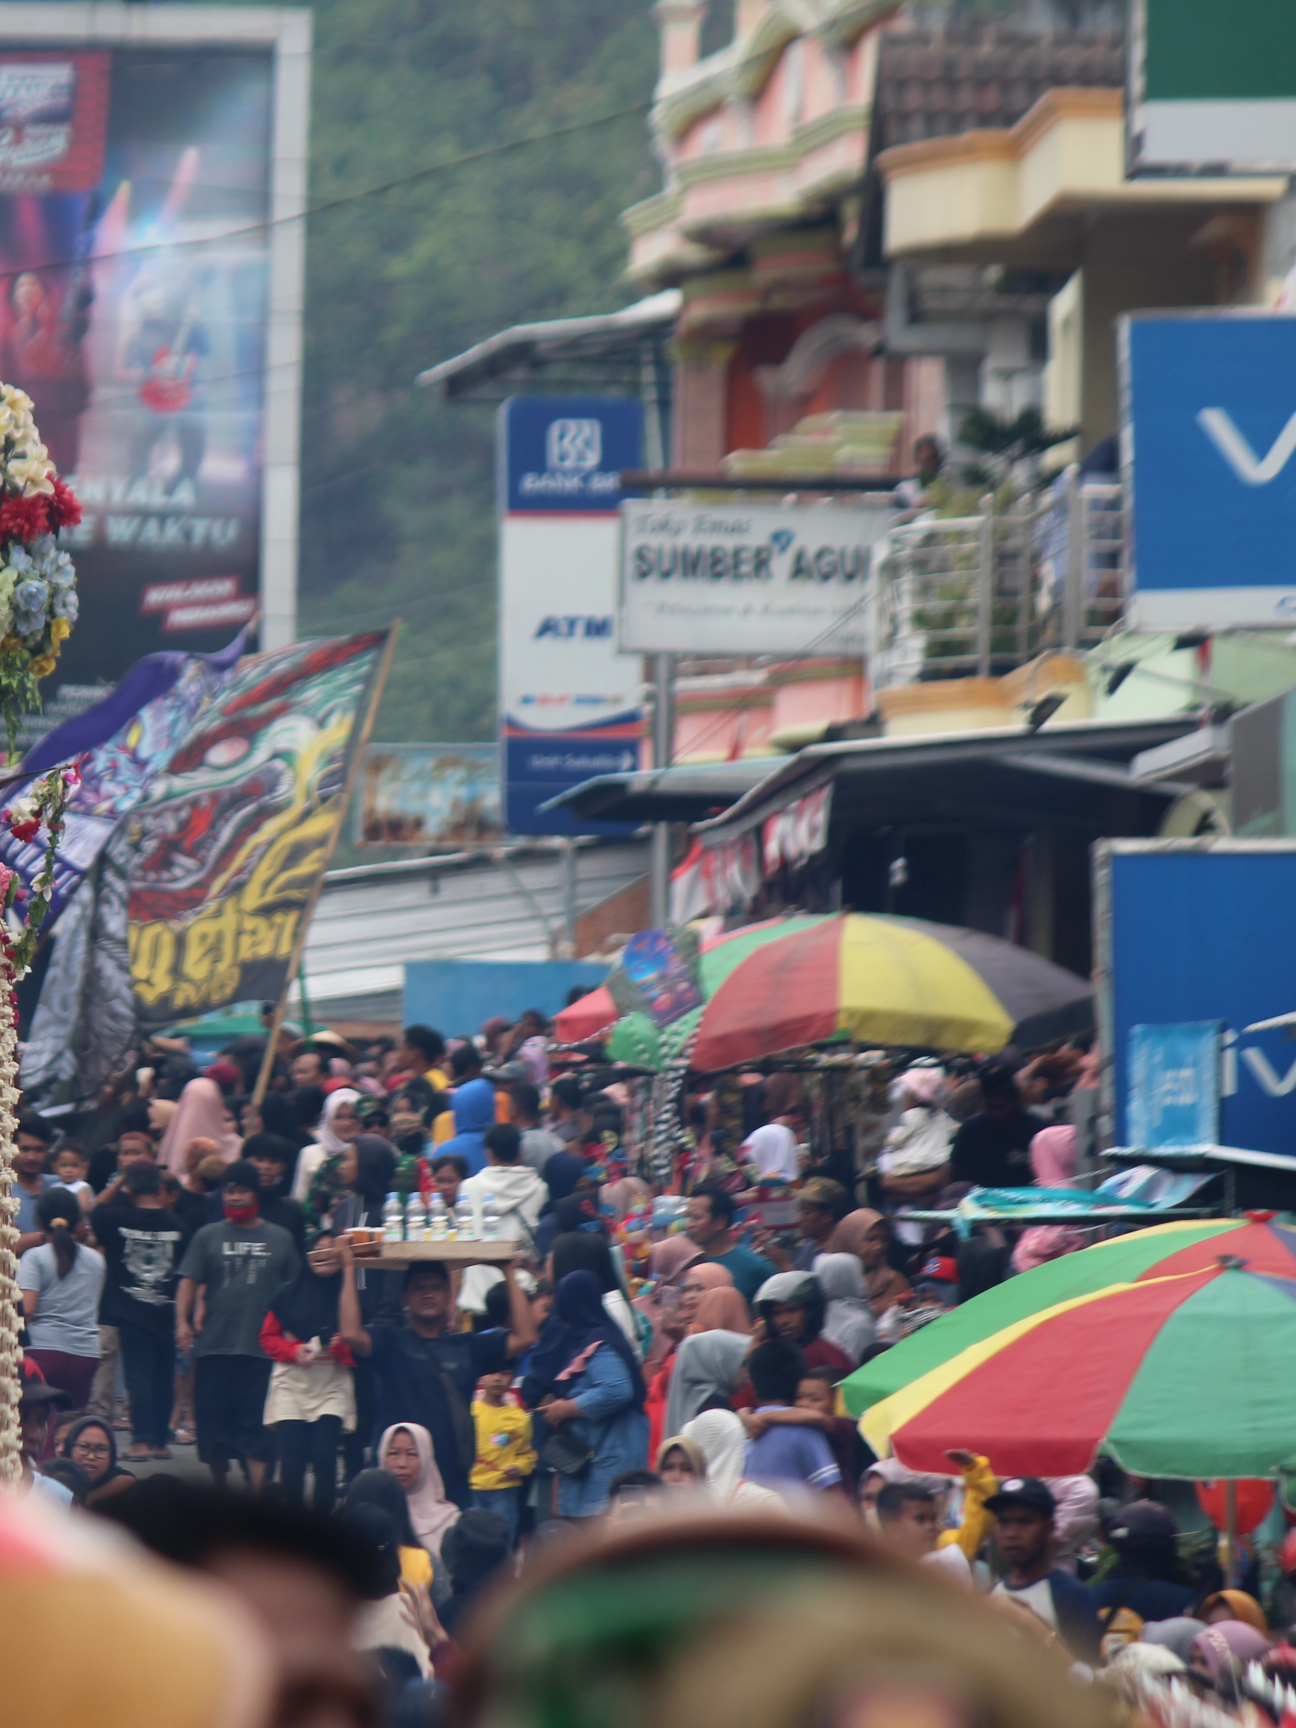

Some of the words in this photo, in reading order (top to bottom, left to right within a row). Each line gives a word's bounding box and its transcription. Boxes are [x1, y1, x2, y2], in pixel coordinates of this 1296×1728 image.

[521, 472, 586, 493] BANK
[106, 516, 240, 546] WAKTU
[634, 543, 773, 581] SUMBER
[535, 615, 613, 639] ATM
